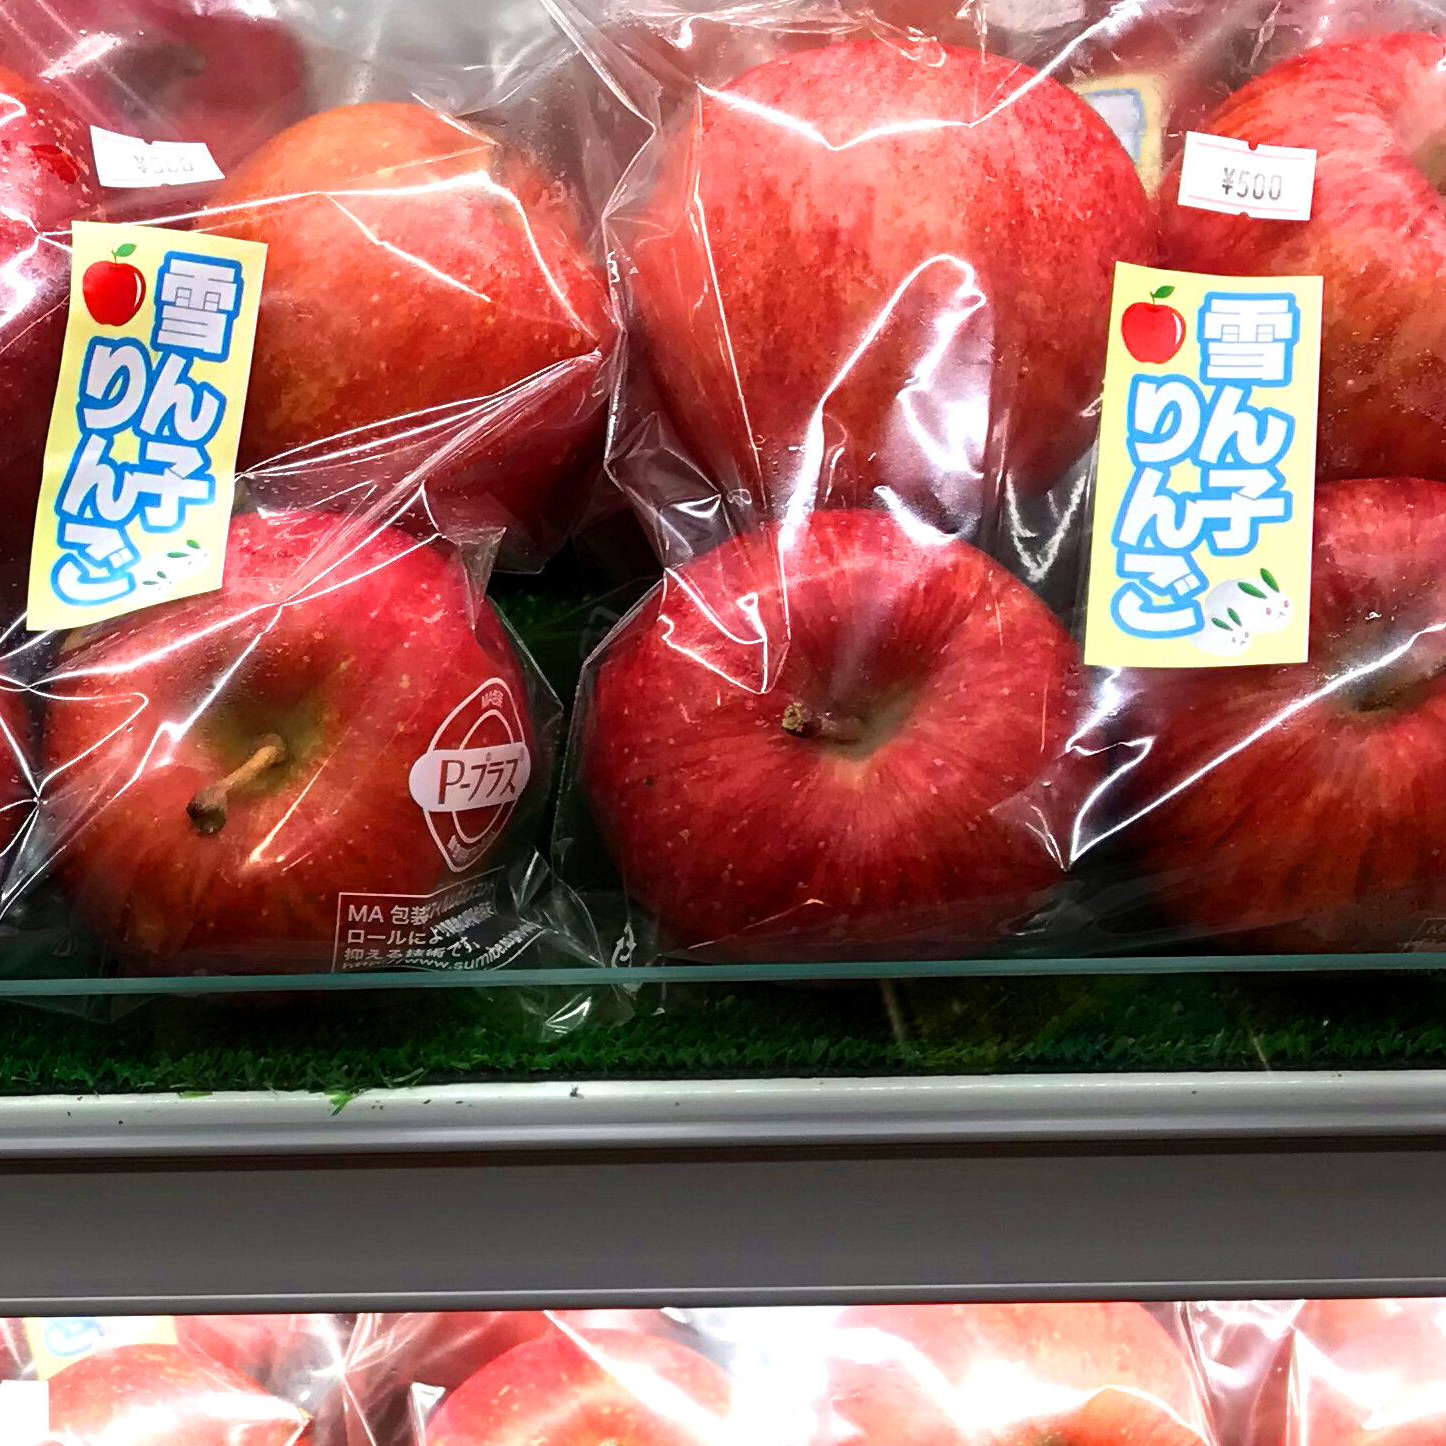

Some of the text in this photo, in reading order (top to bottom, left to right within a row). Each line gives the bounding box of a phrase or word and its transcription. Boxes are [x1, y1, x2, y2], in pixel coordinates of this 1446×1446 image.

[1221, 166, 1283, 201] ¥500
[51, 335, 152, 606] りんご
[140, 250, 244, 532] 雪ん子
[1110, 374, 1208, 639] りんご
[1197, 292, 1300, 556] 雪ん子
